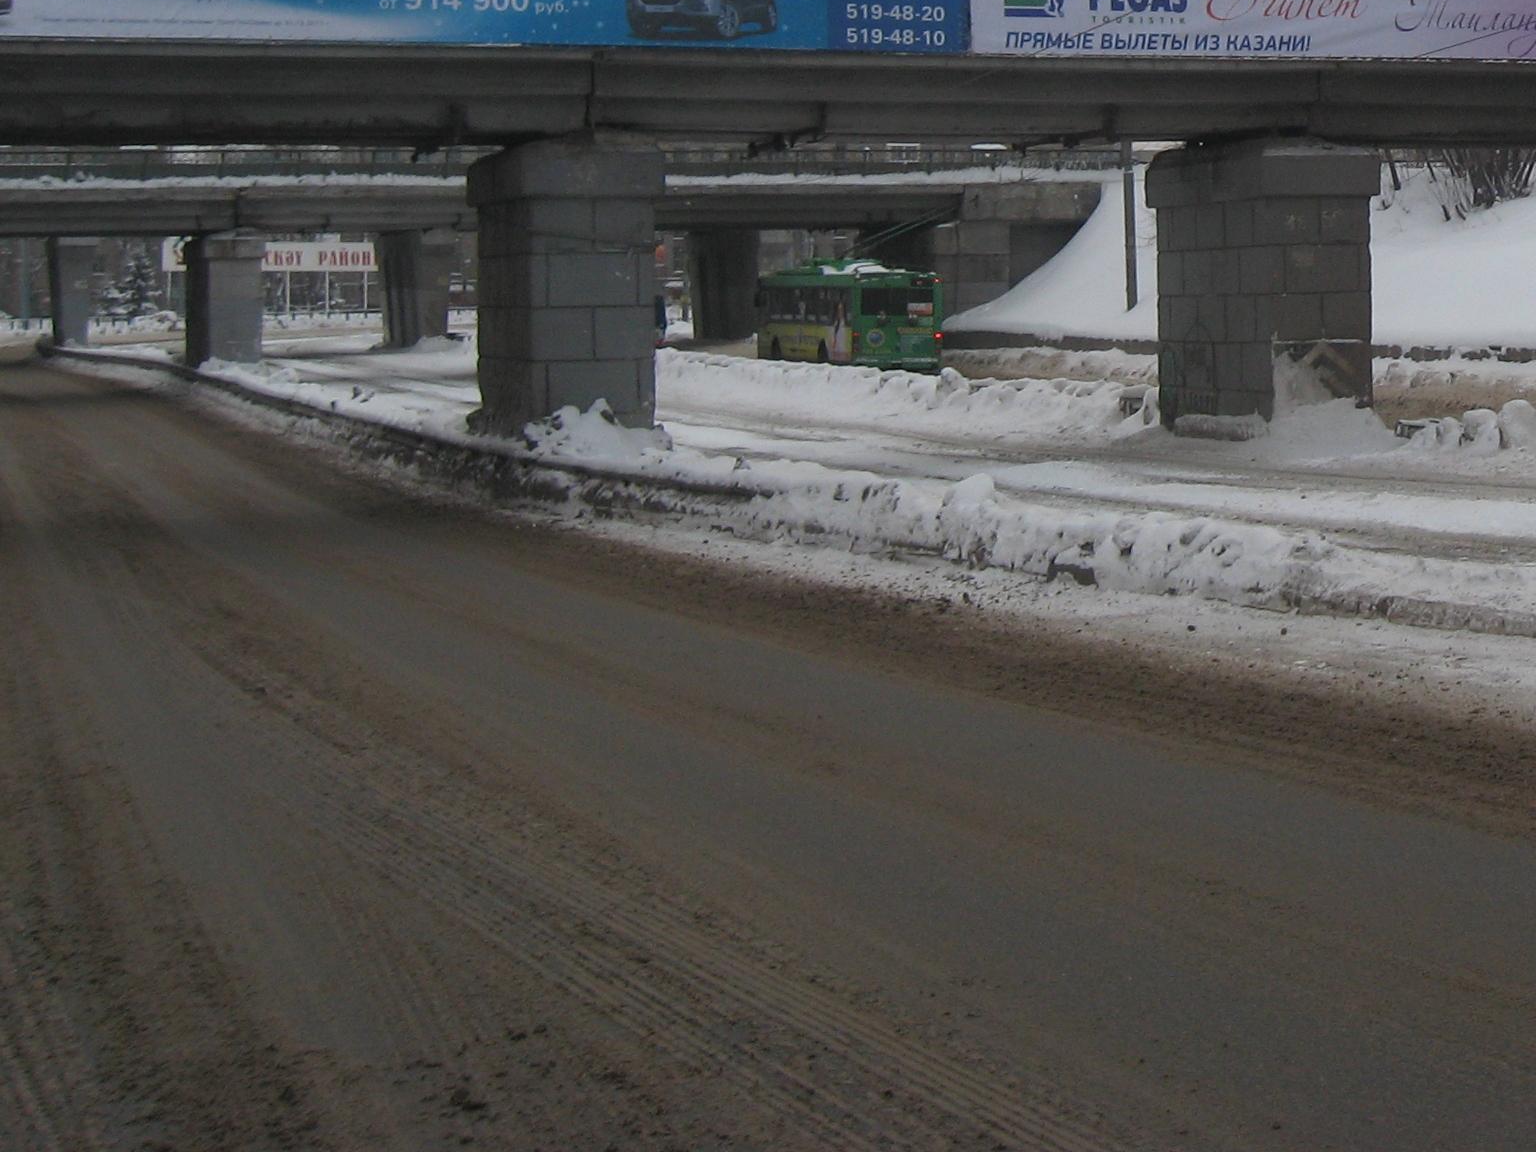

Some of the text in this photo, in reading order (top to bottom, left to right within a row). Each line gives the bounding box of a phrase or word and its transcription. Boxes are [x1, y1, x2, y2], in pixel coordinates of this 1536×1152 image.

[379, 0, 397, 10] от
[846, 3, 945, 22] 519-48-20
[846, 27, 945, 46] 519-48-10
[1005, 31, 1311, 52] ПРЯМЫЕ ВЫЛЕТЫ ИЗ КАЗАНИ!
[318, 249, 379, 266] РАЙОН
